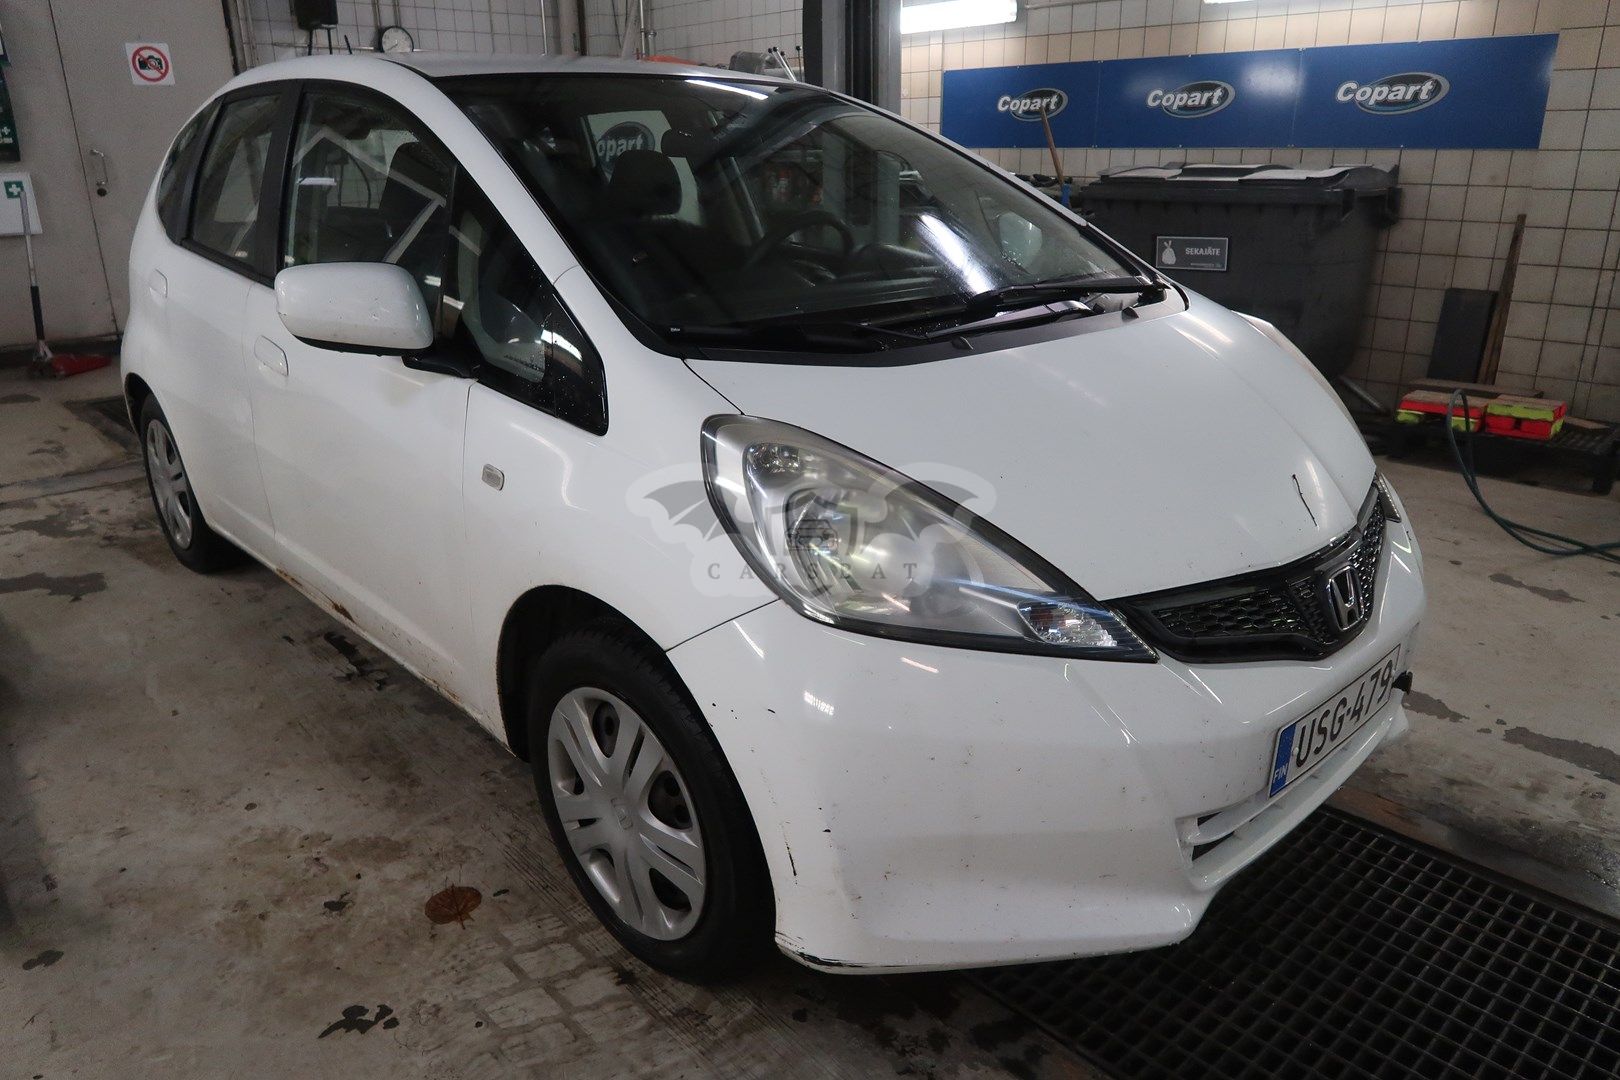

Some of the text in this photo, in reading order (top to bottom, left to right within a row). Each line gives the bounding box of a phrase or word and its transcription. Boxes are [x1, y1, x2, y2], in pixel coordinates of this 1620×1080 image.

[1147, 88, 1222, 110] Copart
[1337, 81, 1434, 105] Copart
[997, 95, 1058, 114] Copart
[596, 134, 643, 162] opart
[1185, 246, 1221, 256] SEKAJÄTE
[1296, 659, 1393, 768] USG-479
[1273, 763, 1289, 784] FIN
